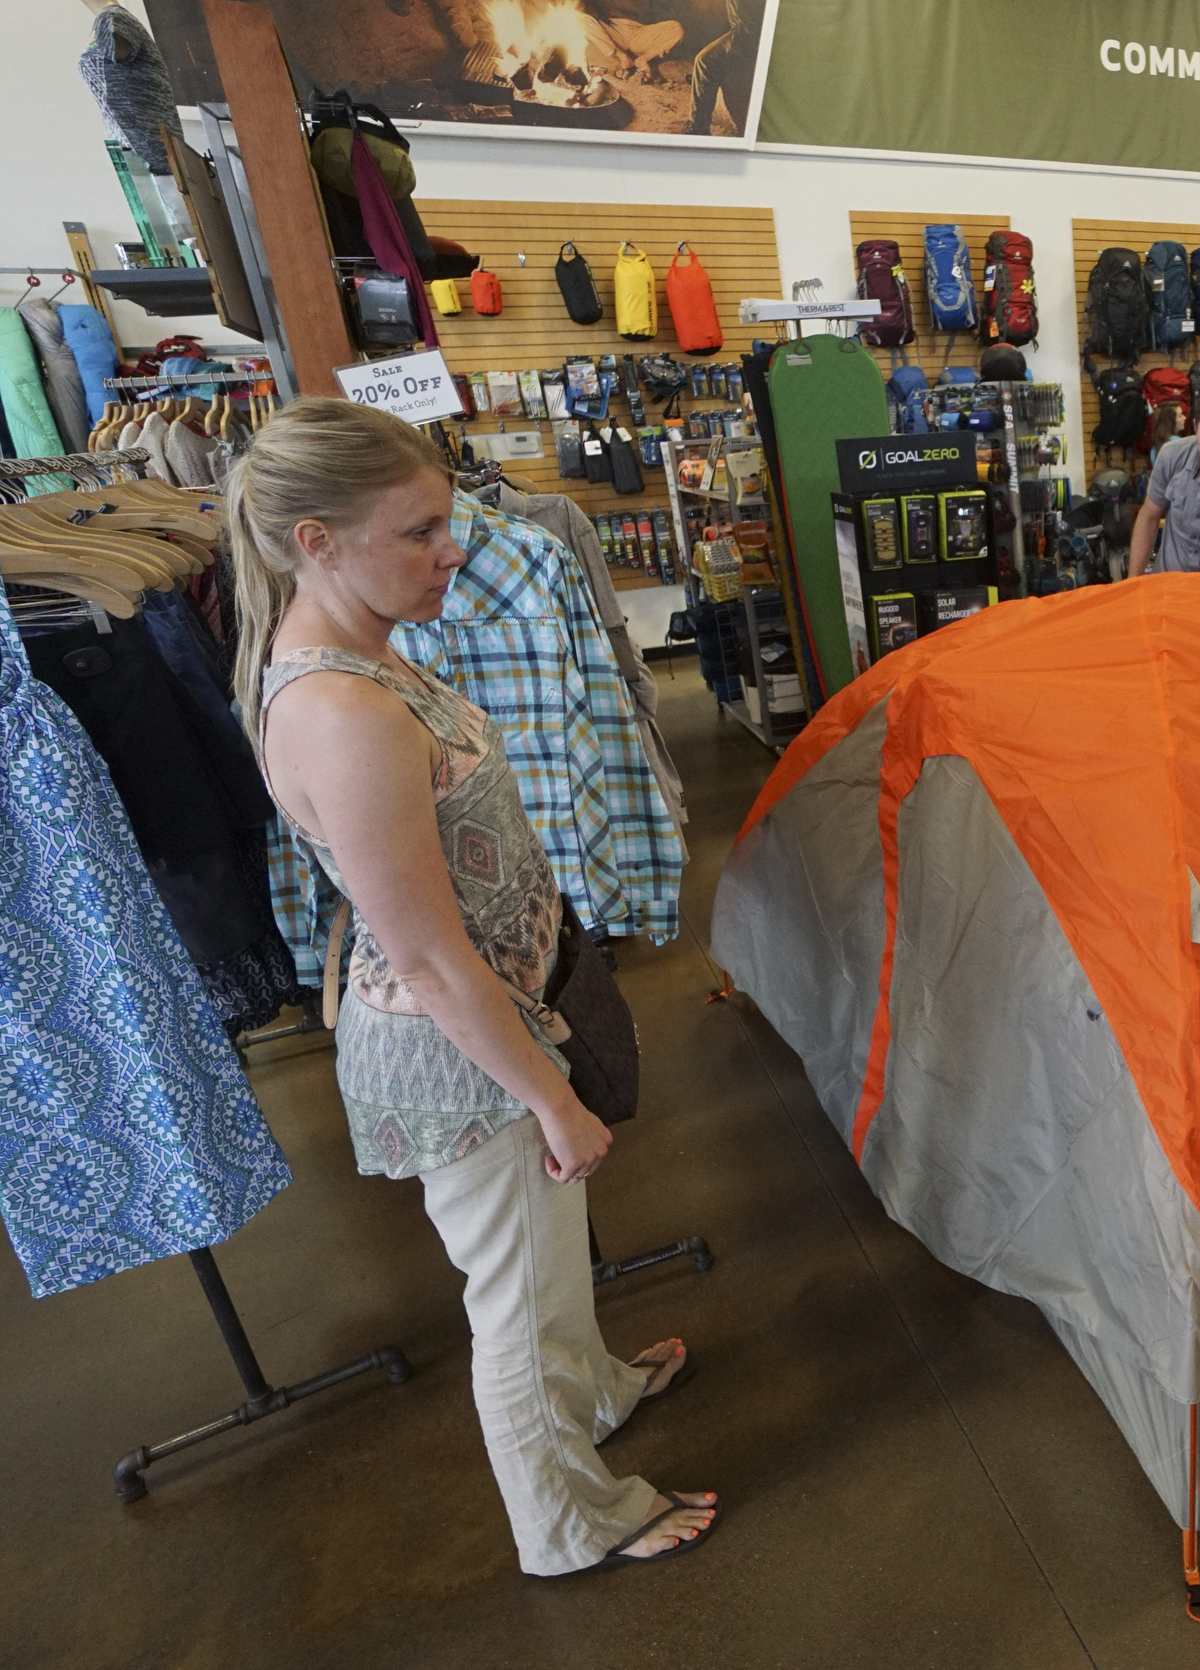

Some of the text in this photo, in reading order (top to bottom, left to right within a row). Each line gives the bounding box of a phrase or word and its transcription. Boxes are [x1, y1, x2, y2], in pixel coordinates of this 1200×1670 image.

[372, 365, 403, 378] SALE
[351, 376, 442, 404] 20% OFF
[390, 402, 414, 414] Rack
[413, 397, 438, 408] Only!
[937, 597, 956, 607] SOLAR
[878, 605, 899, 613] RUGGED
[938, 609, 972, 620] RECHARGER
[878, 616, 902, 625] SPEAKER
